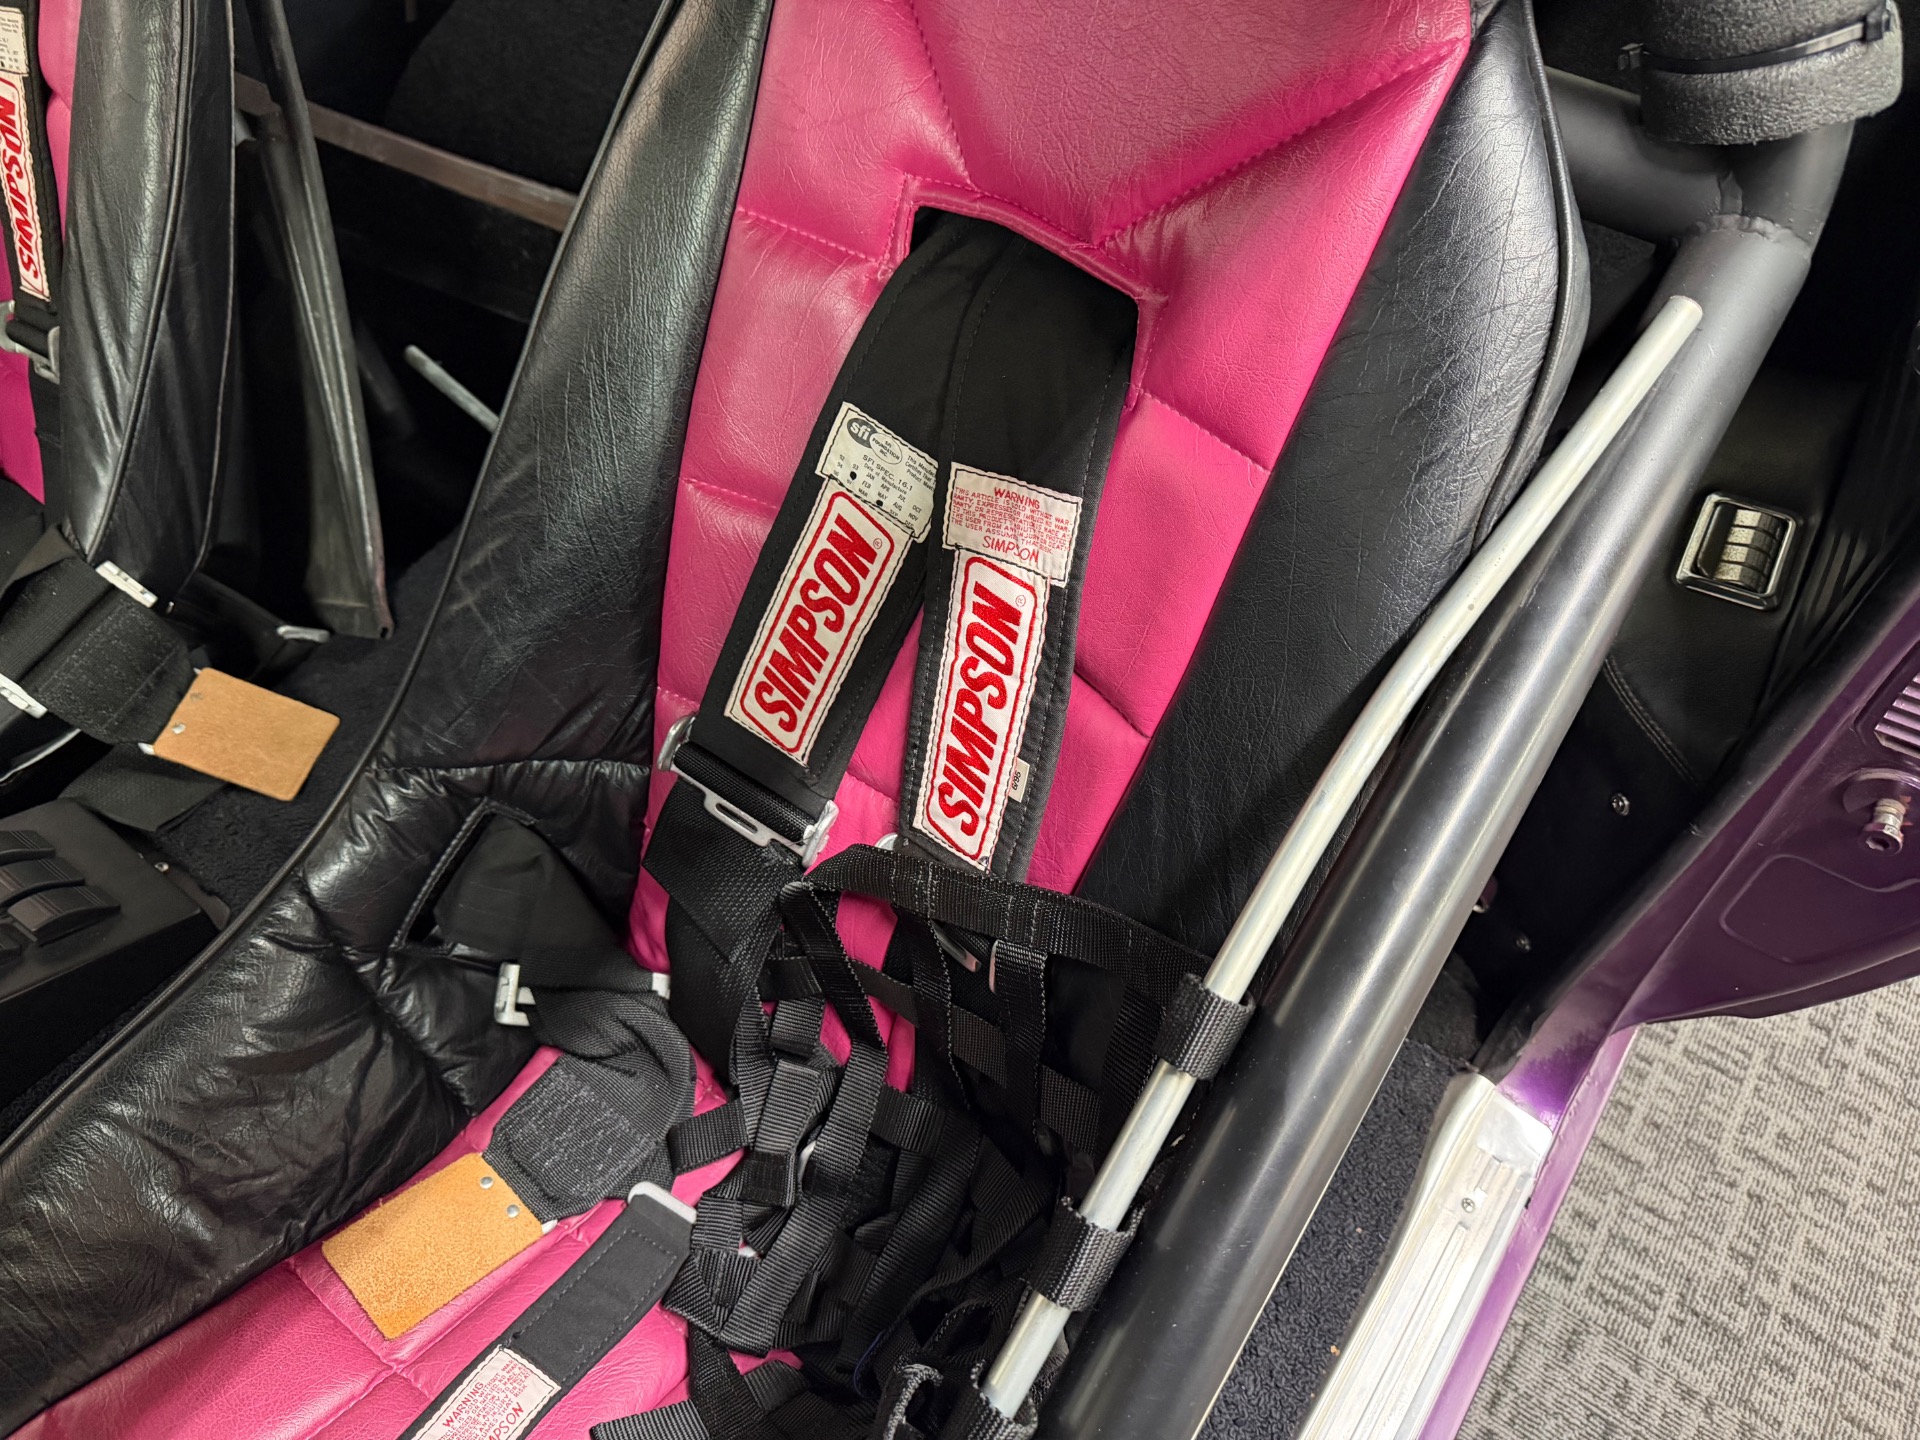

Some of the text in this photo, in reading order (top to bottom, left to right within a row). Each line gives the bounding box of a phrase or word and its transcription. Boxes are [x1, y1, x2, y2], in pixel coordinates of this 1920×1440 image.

[849, 421, 871, 441] sfi
[872, 438, 900, 460] FOUNDATION
[863, 455, 912, 490] SFI SPEC. 16.1
[866, 472, 875, 480] JAN
[880, 484, 890, 492] APR
[859, 488, 868, 497] MAR
[882, 476, 907, 494] Manufacture
[955, 486, 969, 496] THIS
[971, 492, 1000, 504] ARTICLE
[878, 492, 887, 500] MAY
[893, 502, 902, 511] AUG
[908, 513, 918, 521] NOV
[994, 488, 1040, 510] WARNING
[952, 510, 964, 519] THE
[965, 514, 982, 525] USER
[984, 520, 1002, 530] FROM
[962, 508, 976, 518] THIS
[952, 516, 962, 526] THE
[966, 521, 983, 532] USER
[1044, 527, 1060, 536] MADE
[982, 535, 1040, 563] SIMPSON
[754, 513, 879, 732] SIMPSON
[938, 583, 1022, 836] SIMPSON
[502, 1372, 517, 1386] MADE
[465, 1398, 478, 1414] SOLD
[478, 1373, 500, 1398] WITHOUT
[443, 1382, 484, 1427] WARNING
[472, 1405, 480, 1414] OR
[480, 1419, 490, 1432] ANY
[490, 1394, 508, 1417] INJURY
[508, 1386, 518, 1394] OR
[482, 1396, 500, 1419] ABILITY
[498, 1398, 512, 1416] THAT
